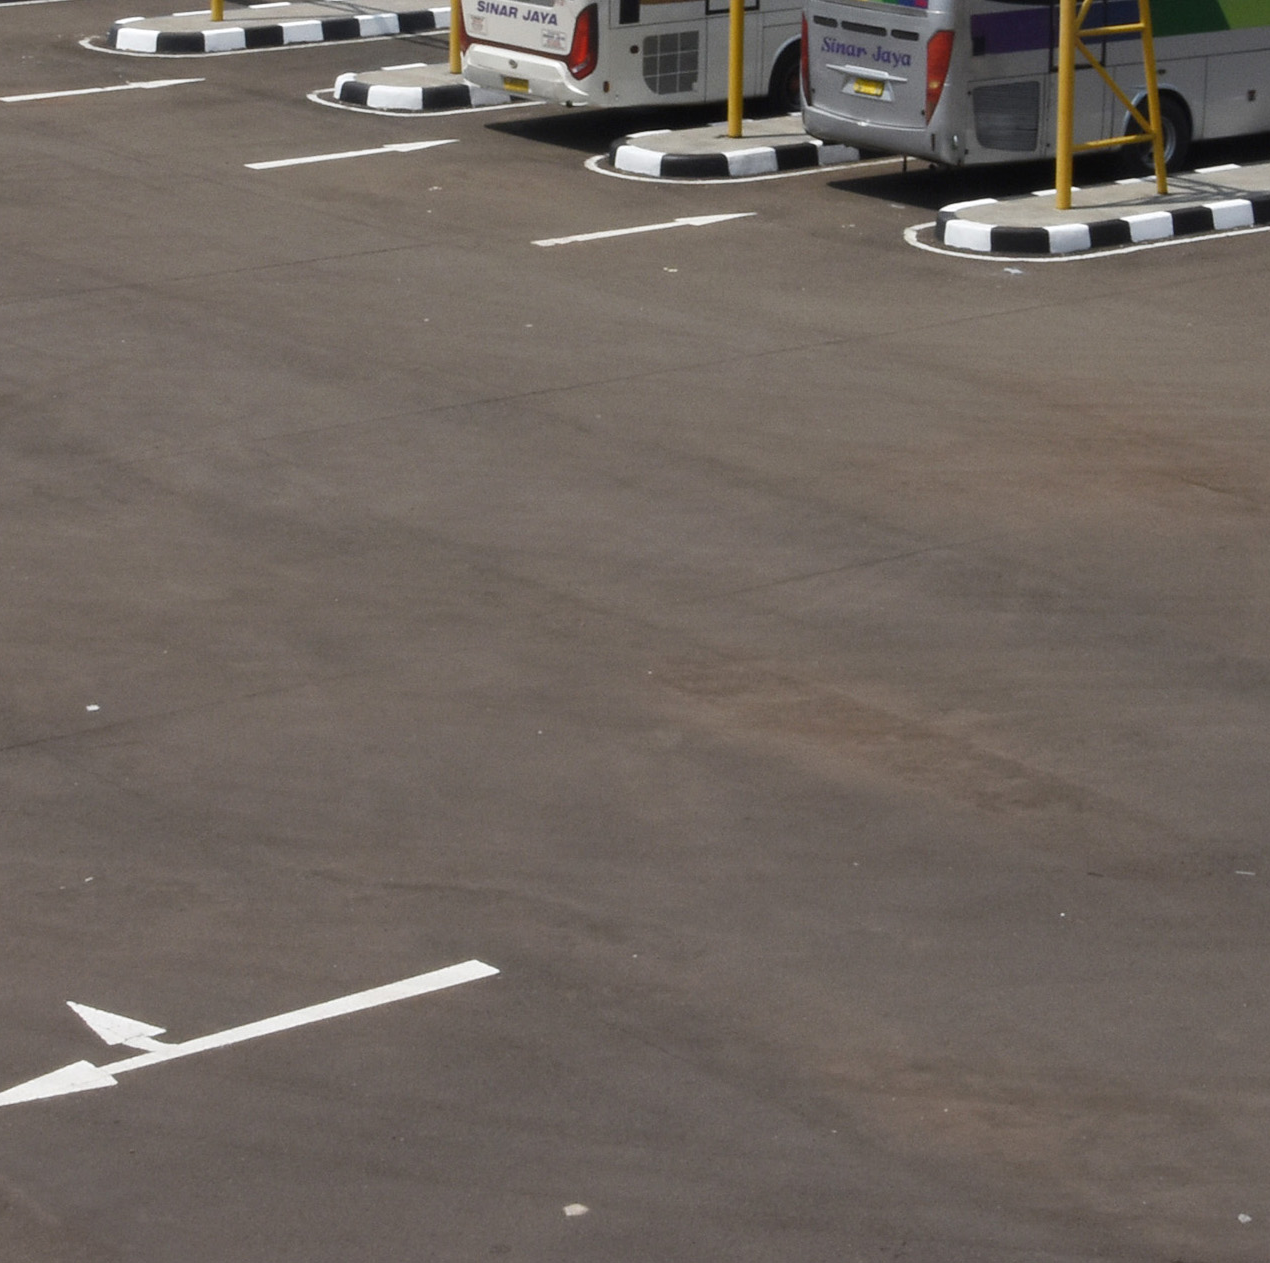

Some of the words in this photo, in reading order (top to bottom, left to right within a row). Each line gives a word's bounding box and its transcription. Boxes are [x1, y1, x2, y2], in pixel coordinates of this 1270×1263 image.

[477, 0, 519, 19] SINAR
[522, 9, 558, 26] JAYA
[821, 36, 867, 58] Sinar
[872, 45, 912, 68] Jaya
